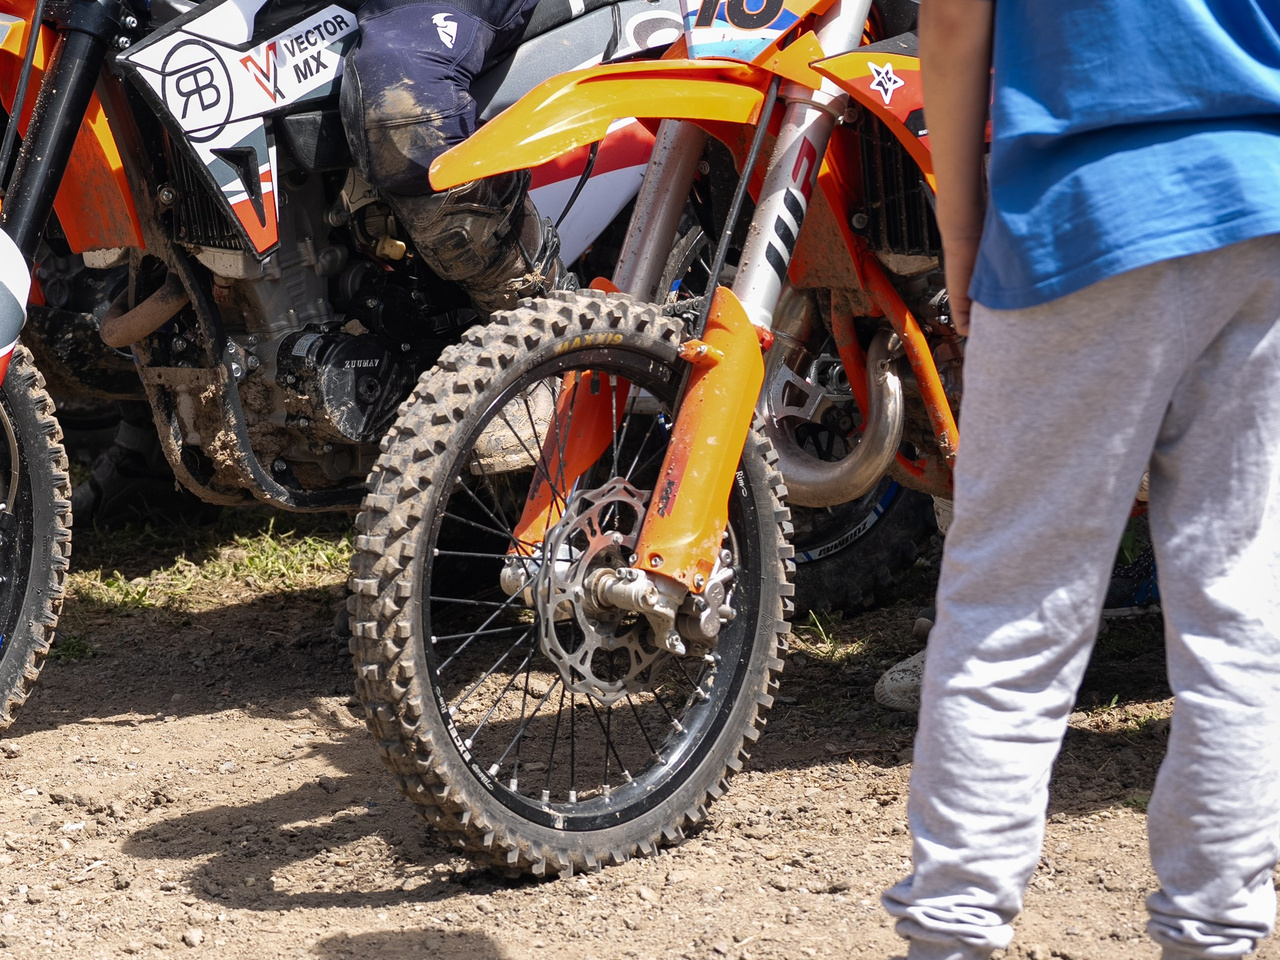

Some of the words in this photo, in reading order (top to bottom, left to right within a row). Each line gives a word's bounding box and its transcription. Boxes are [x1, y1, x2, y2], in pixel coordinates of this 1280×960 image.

[284, 14, 351, 55] VECTOR
[293, 51, 329, 85] MX
[553, 333, 624, 356] MAXXIS
[344, 359, 380, 369] ZUUMAV
[447, 719, 472, 762] EXCEL
